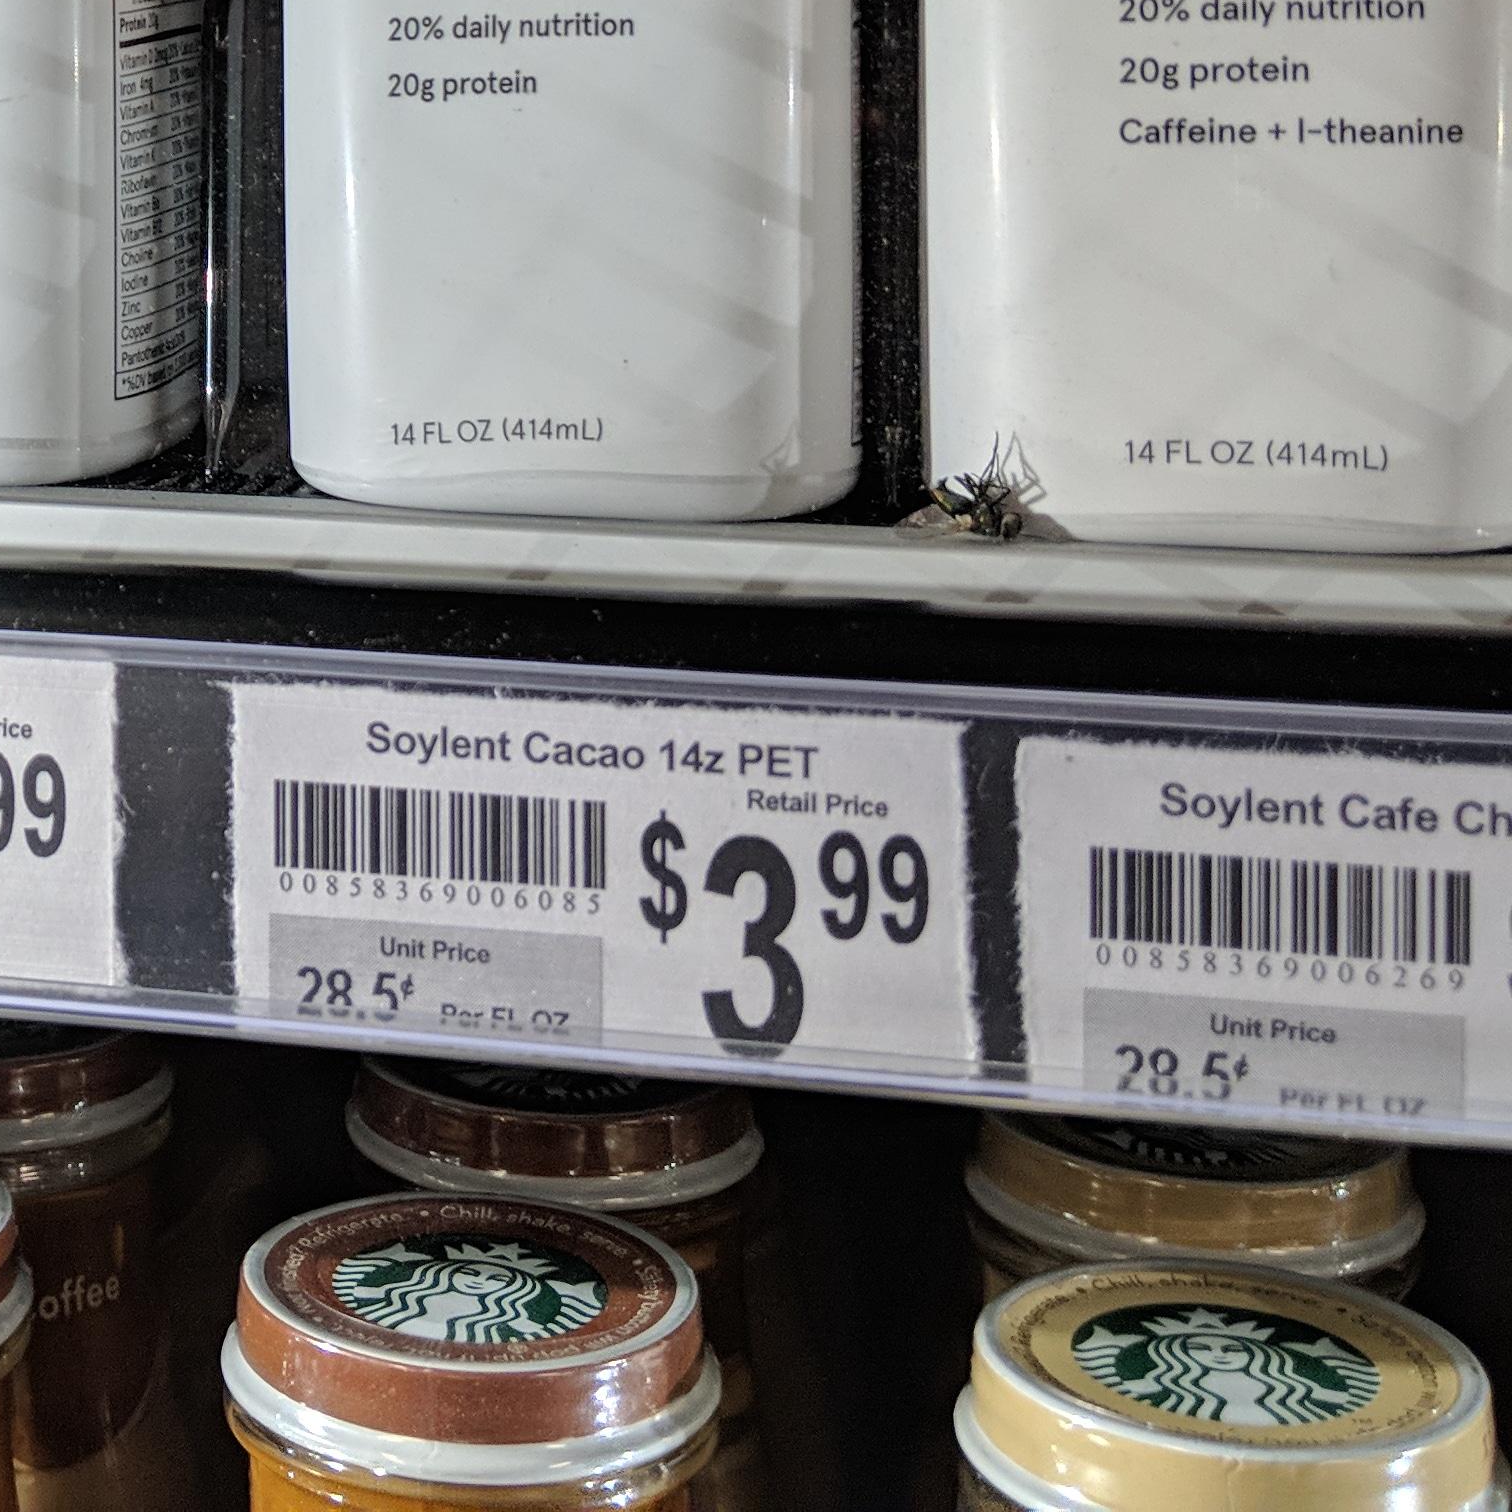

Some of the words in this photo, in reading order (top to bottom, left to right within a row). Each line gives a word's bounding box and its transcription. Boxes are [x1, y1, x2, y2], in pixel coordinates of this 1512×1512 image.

[388, 16, 444, 42] 20%
[452, 14, 511, 44] daily
[519, 12, 635, 39] nutrition
[388, 73, 435, 102] 20g
[443, 70, 537, 102] protein
[1119, 57, 1179, 89] 20g
[1190, 55, 1311, 90] protein
[1119, 118, 1257, 145] Caffeine
[391, 422, 415, 445] 14
[423, 421, 452, 444] FL
[457, 419, 494, 443] OZ
[502, 418, 604, 442] (414mL)
[1124, 440, 1155, 465] 14
[1165, 440, 1201, 465] FL
[1210, 440, 1255, 466] OZ
[1266, 440, 1389, 472] (414mL)
[366, 722, 511, 764] Soylent
[524, 731, 645, 770] Cacao
[659, 739, 725, 774] 14z
[738, 745, 819, 779] PET
[747, 789, 817, 815] Retail
[825, 793, 888, 819] Price
[1160, 782, 1325, 829] Soylent
[1339, 793, 1439, 834] Cafe
[380, 937, 427, 960] Unit
[433, 940, 491, 965] Price
[1210, 1012, 1263, 1040] Unit
[1271, 1017, 1338, 1045] Price
[28, 1272, 122, 1324] offee
